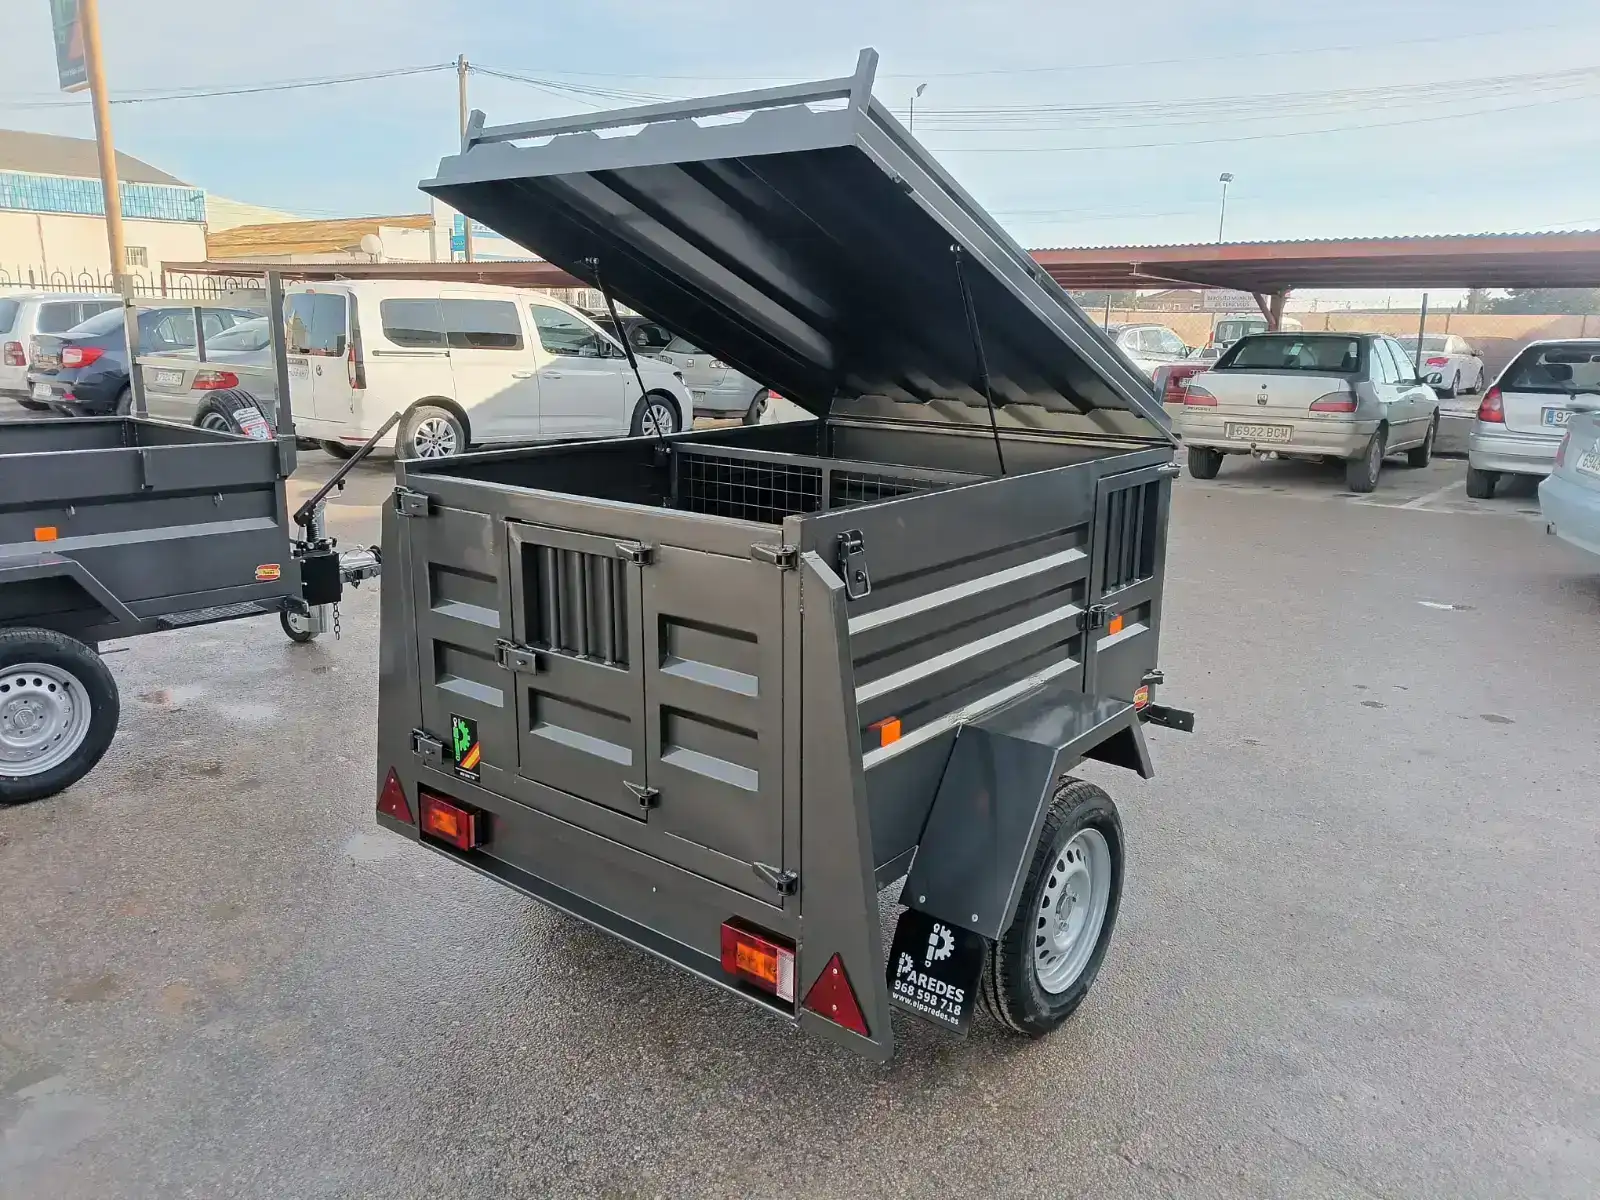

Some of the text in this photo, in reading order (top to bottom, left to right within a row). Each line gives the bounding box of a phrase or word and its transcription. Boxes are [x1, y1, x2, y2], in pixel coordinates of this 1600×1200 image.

[1235, 426, 1264, 439] 6922
[892, 991, 960, 1025] www.elparedes.es
[894, 980, 962, 1016] 968 598 718
